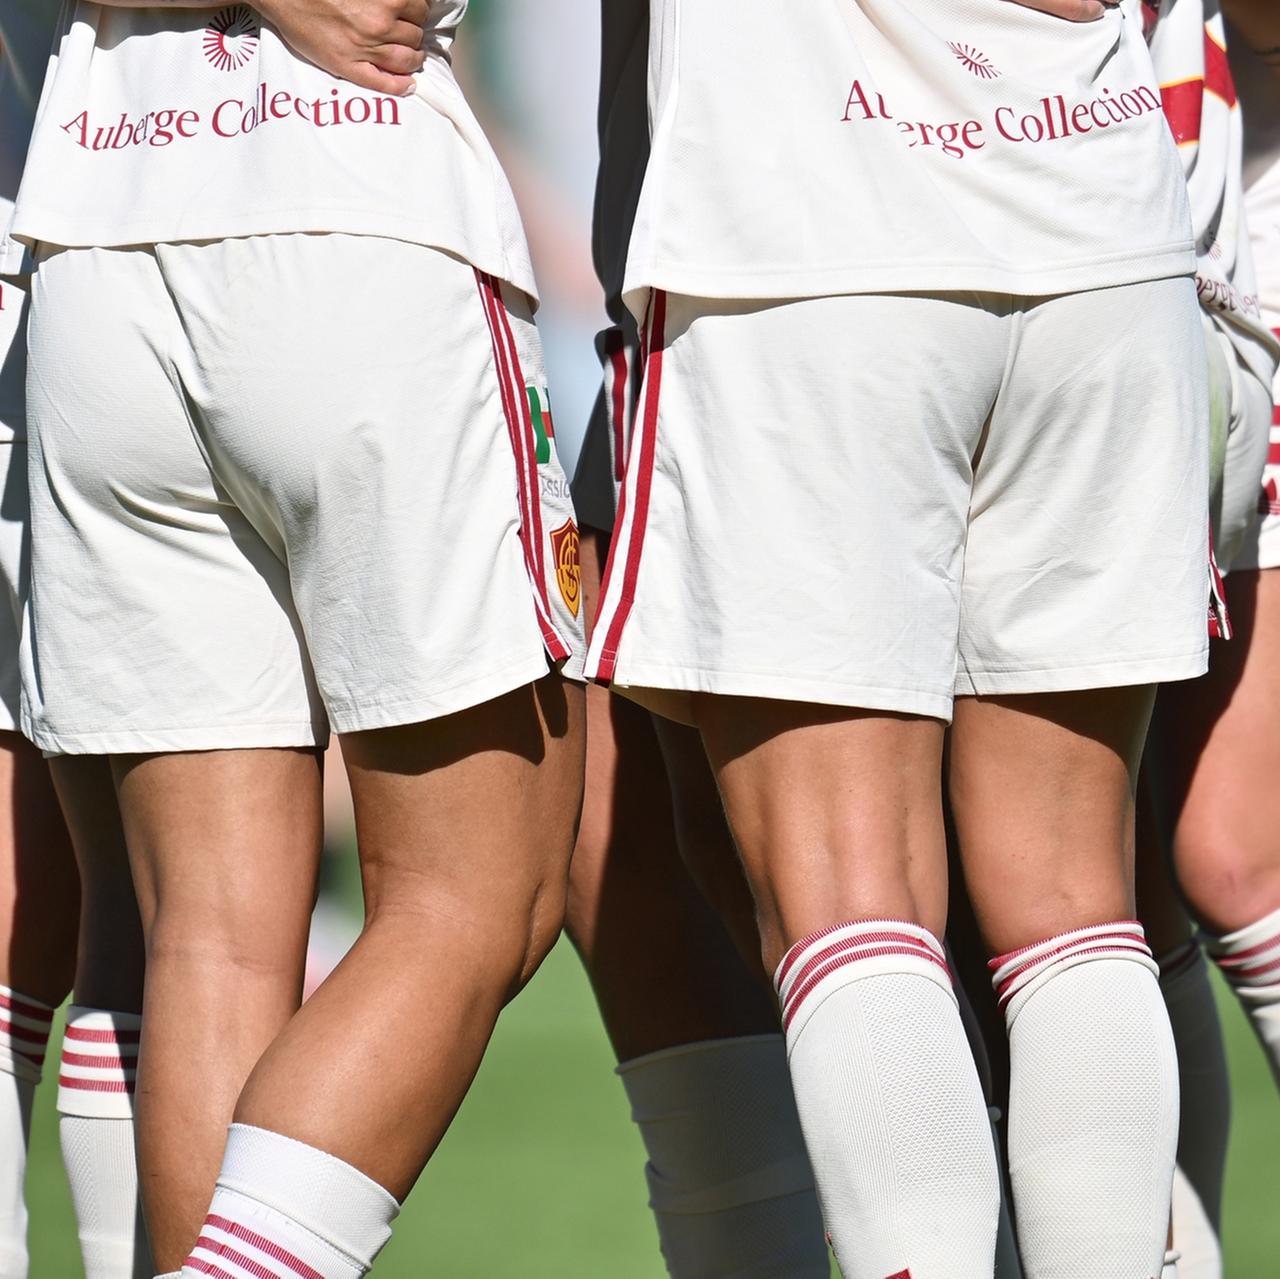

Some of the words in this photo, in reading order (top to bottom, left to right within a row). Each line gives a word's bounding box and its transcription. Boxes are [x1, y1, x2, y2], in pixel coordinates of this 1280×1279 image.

[60, 109, 200, 151] Auberge
[211, 82, 403, 138] Collection
[994, 83, 1163, 143] Collection
